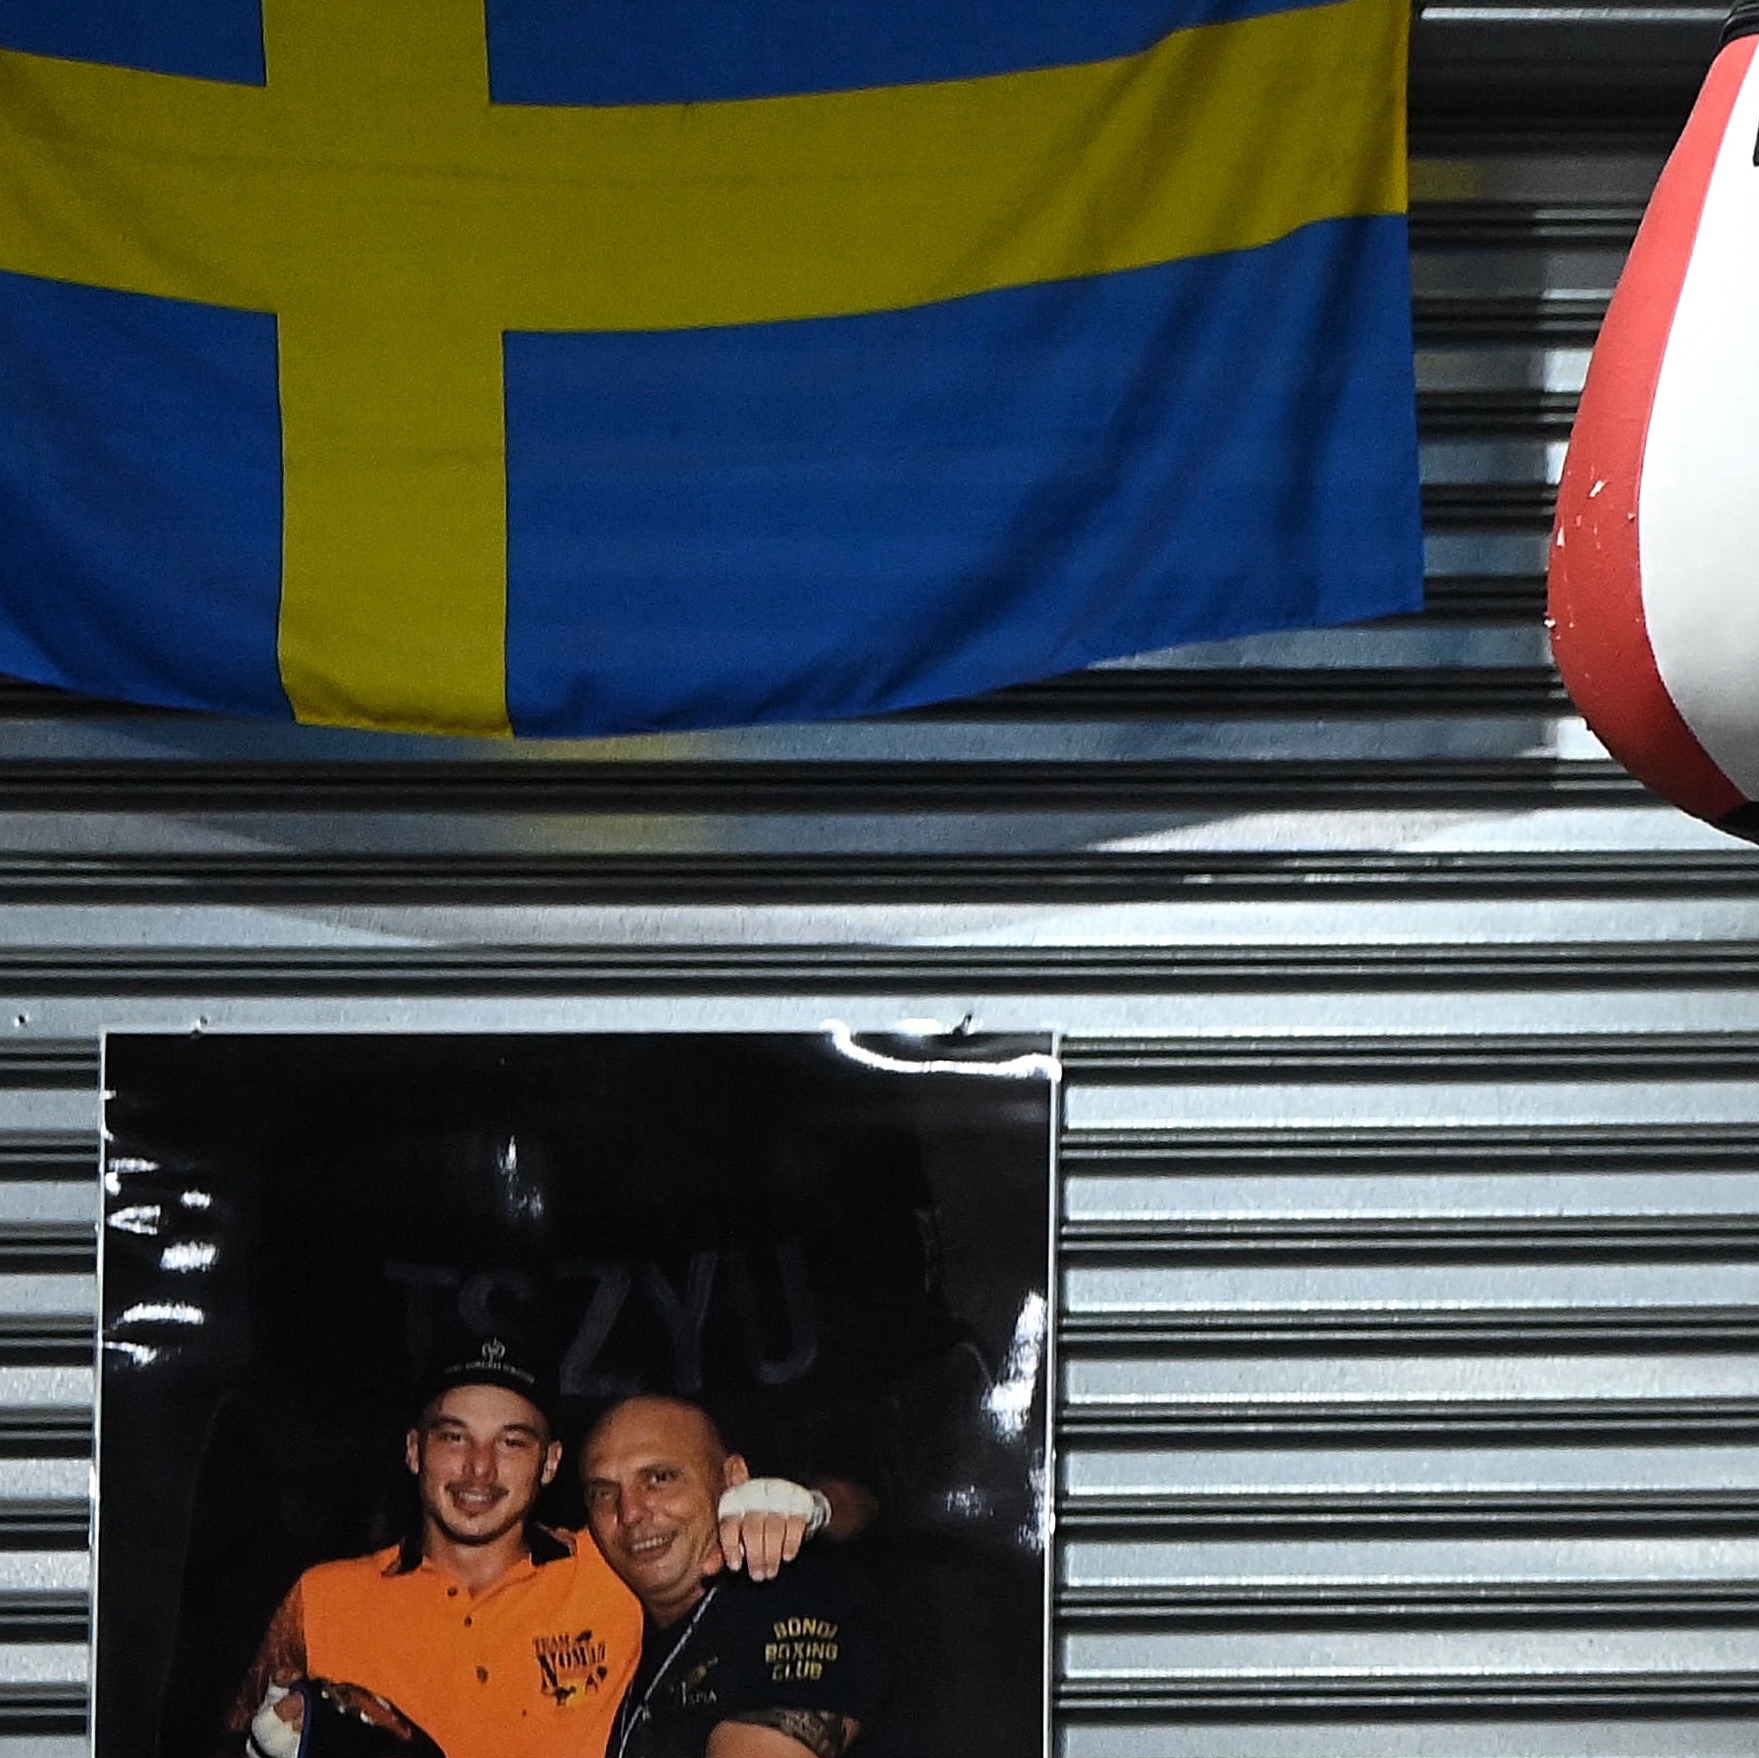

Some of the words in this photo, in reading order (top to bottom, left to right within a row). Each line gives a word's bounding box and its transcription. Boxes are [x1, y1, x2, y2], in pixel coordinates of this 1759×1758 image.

[772, 1615, 839, 1641] BONDI
[764, 1641, 840, 1665] BOXING
[771, 1659, 826, 1682] CLUB
